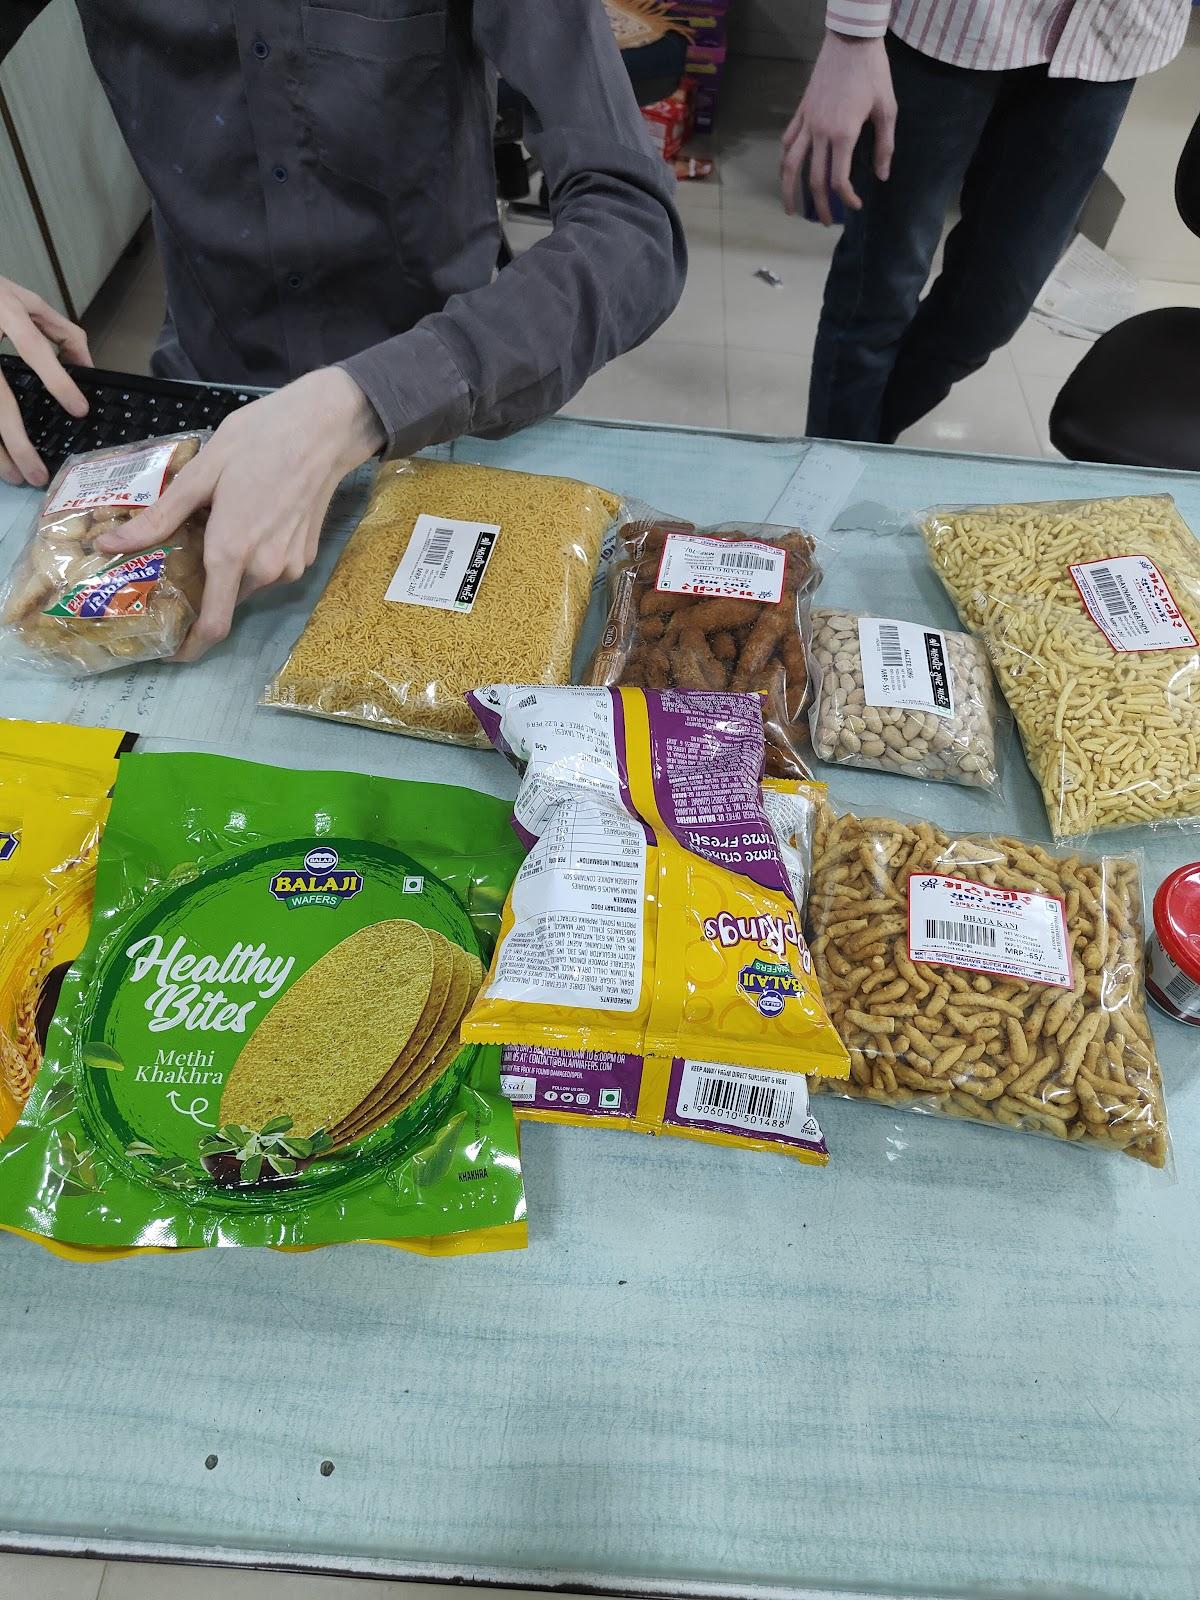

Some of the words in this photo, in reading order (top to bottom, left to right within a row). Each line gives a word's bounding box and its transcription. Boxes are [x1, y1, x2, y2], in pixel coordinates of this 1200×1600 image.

[535, 743, 548, 752] 45g
[603, 827, 639, 838] CARBOHYDRATES
[610, 860, 639, 868] NUTRITIONAL
[573, 874, 596, 883] CONTAINS
[615, 877, 638, 886] ALLERGEN
[274, 876, 358, 892] BALAJI
[571, 882, 597, 892] SAVOURIES
[602, 886, 620, 894] SNACKS
[291, 895, 337, 906] WAFERS
[604, 905, 637, 914] PROPRIETARY
[559, 916, 578, 924] EXTRACT
[578, 917, 598, 925] PAPRIKA
[963, 915, 994, 925] BHATA
[996, 920, 1018, 930] KANI
[617, 921, 637, 929] PROTEIN
[572, 932, 593, 940] NATURAL
[607, 928, 637, 937] SUBSTANCES
[589, 950, 616, 959] REGULATOR
[126, 935, 295, 999] Healthy
[588, 958, 609, 967] POWDER
[609, 960, 635, 969] VEGETABLE
[742, 973, 802, 992] BALAJI
[144, 984, 257, 1033] Bites
[154, 1049, 215, 1067] Methi
[586, 1051, 593, 1060] TO
[617, 1054, 626, 1064] OR
[134, 1065, 224, 1084] Khakhra
[535, 1067, 550, 1075] FOUND
[732, 1070, 748, 1080] DIRECT
[748, 1073, 770, 1083] SUNLIGHT
[775, 1078, 787, 1086] HEAT
[683, 1103, 689, 1111] 8
[696, 1105, 738, 1120] 906010
[744, 1114, 785, 1128] 501488
[458, 1168, 489, 1182] KHAKHRA
